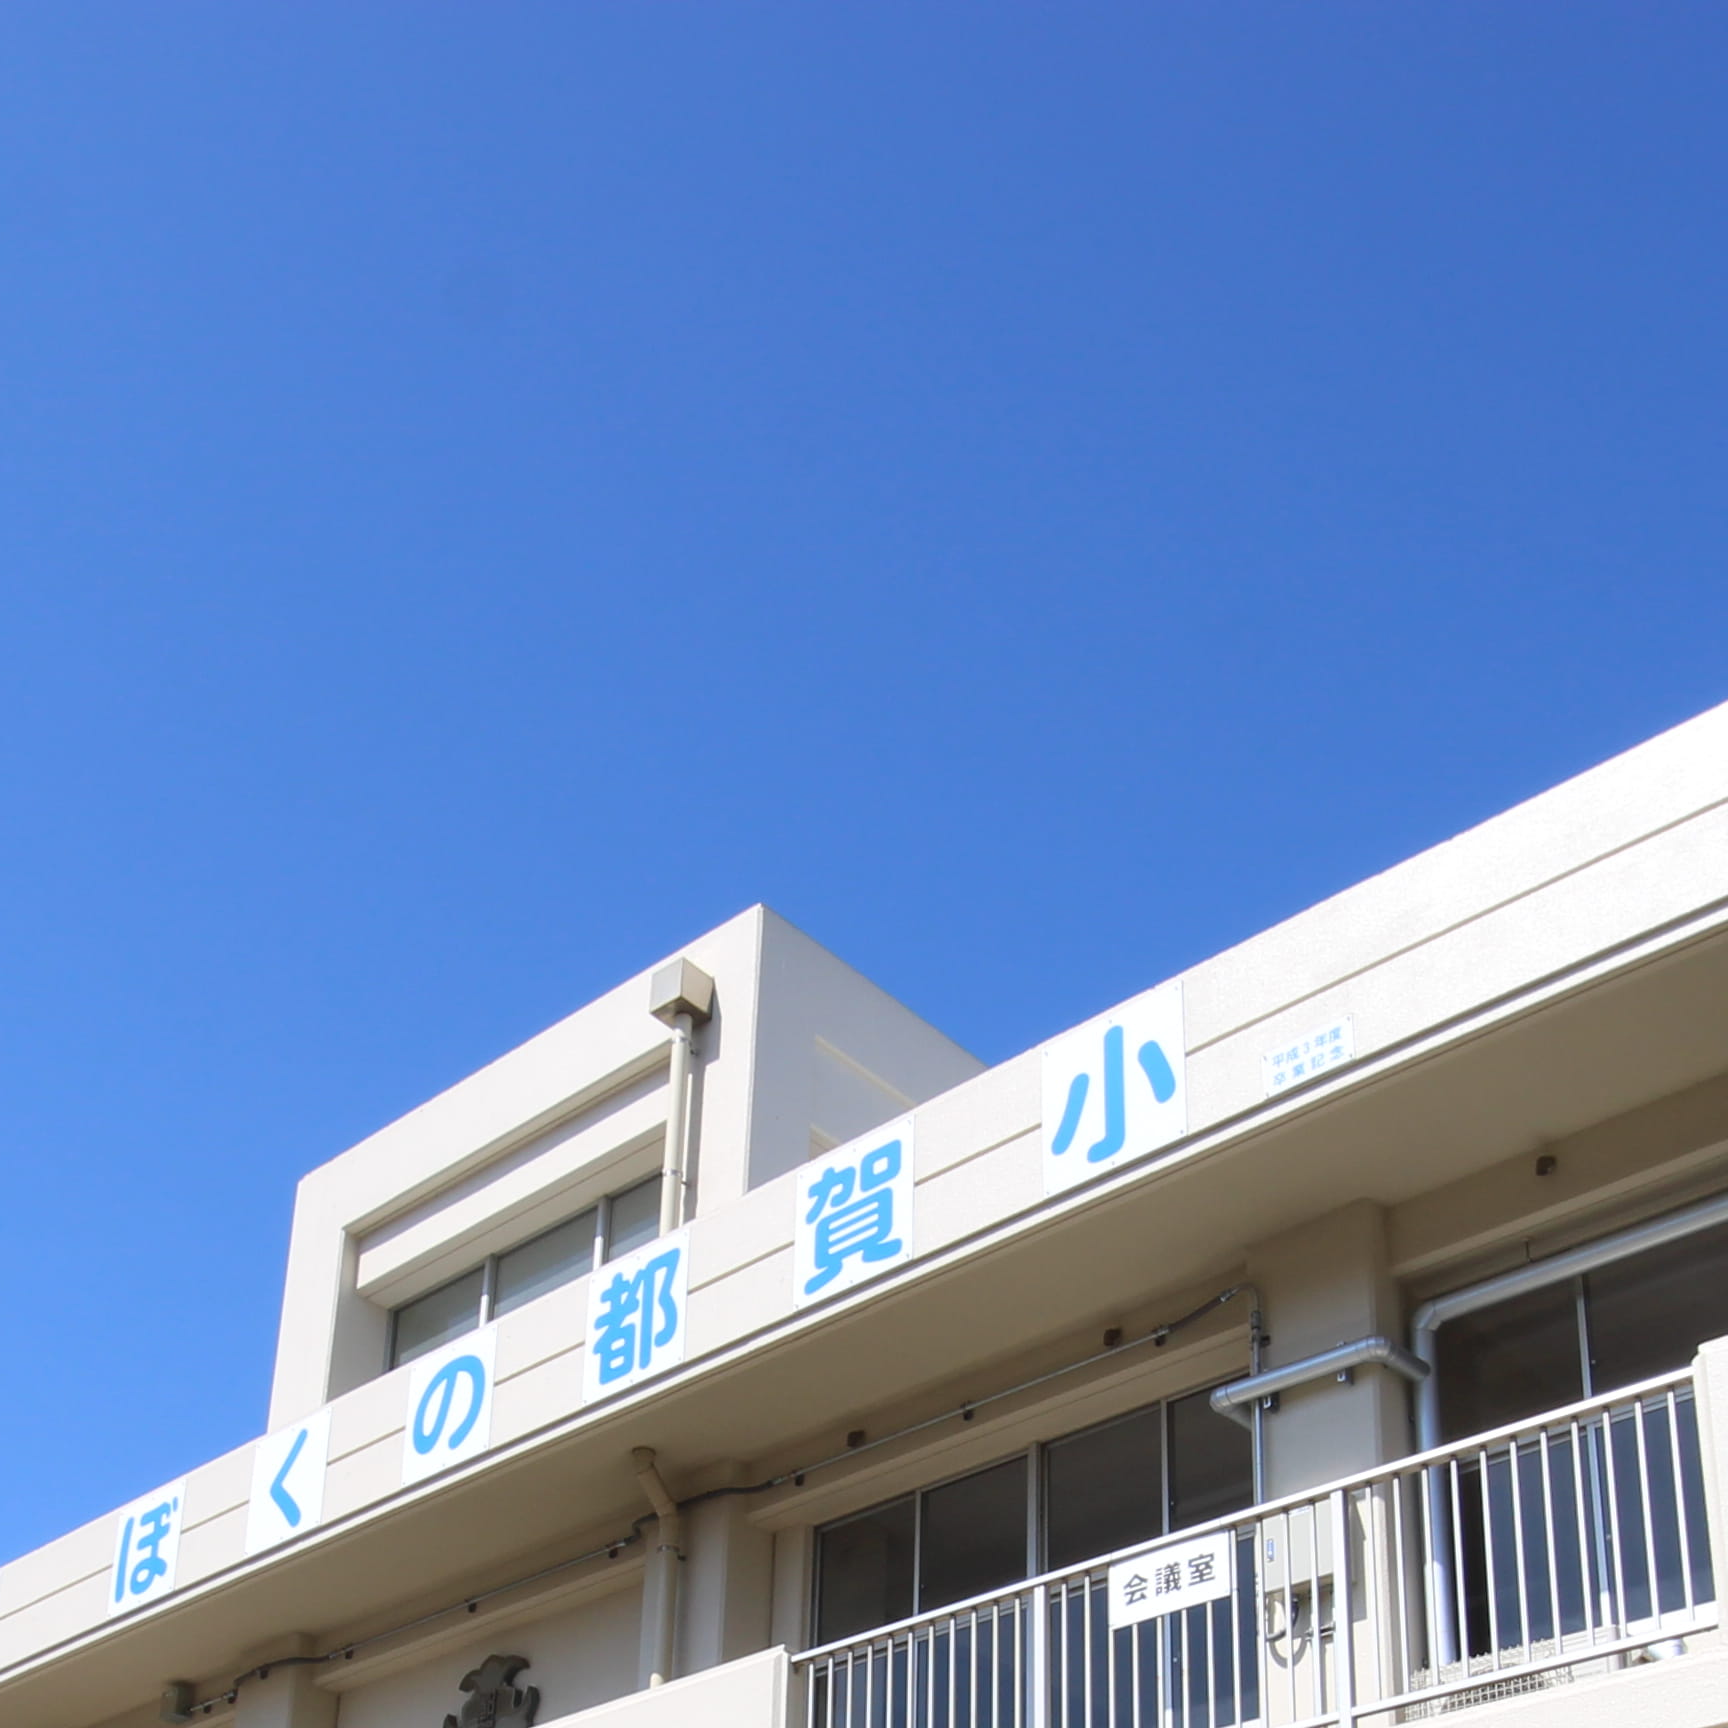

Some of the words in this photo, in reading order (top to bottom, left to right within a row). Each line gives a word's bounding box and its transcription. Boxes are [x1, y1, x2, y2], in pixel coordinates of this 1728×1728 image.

[114, 1024, 1177, 1604] ぼくの都賀小
[1123, 1551, 1216, 1607] 会議室
